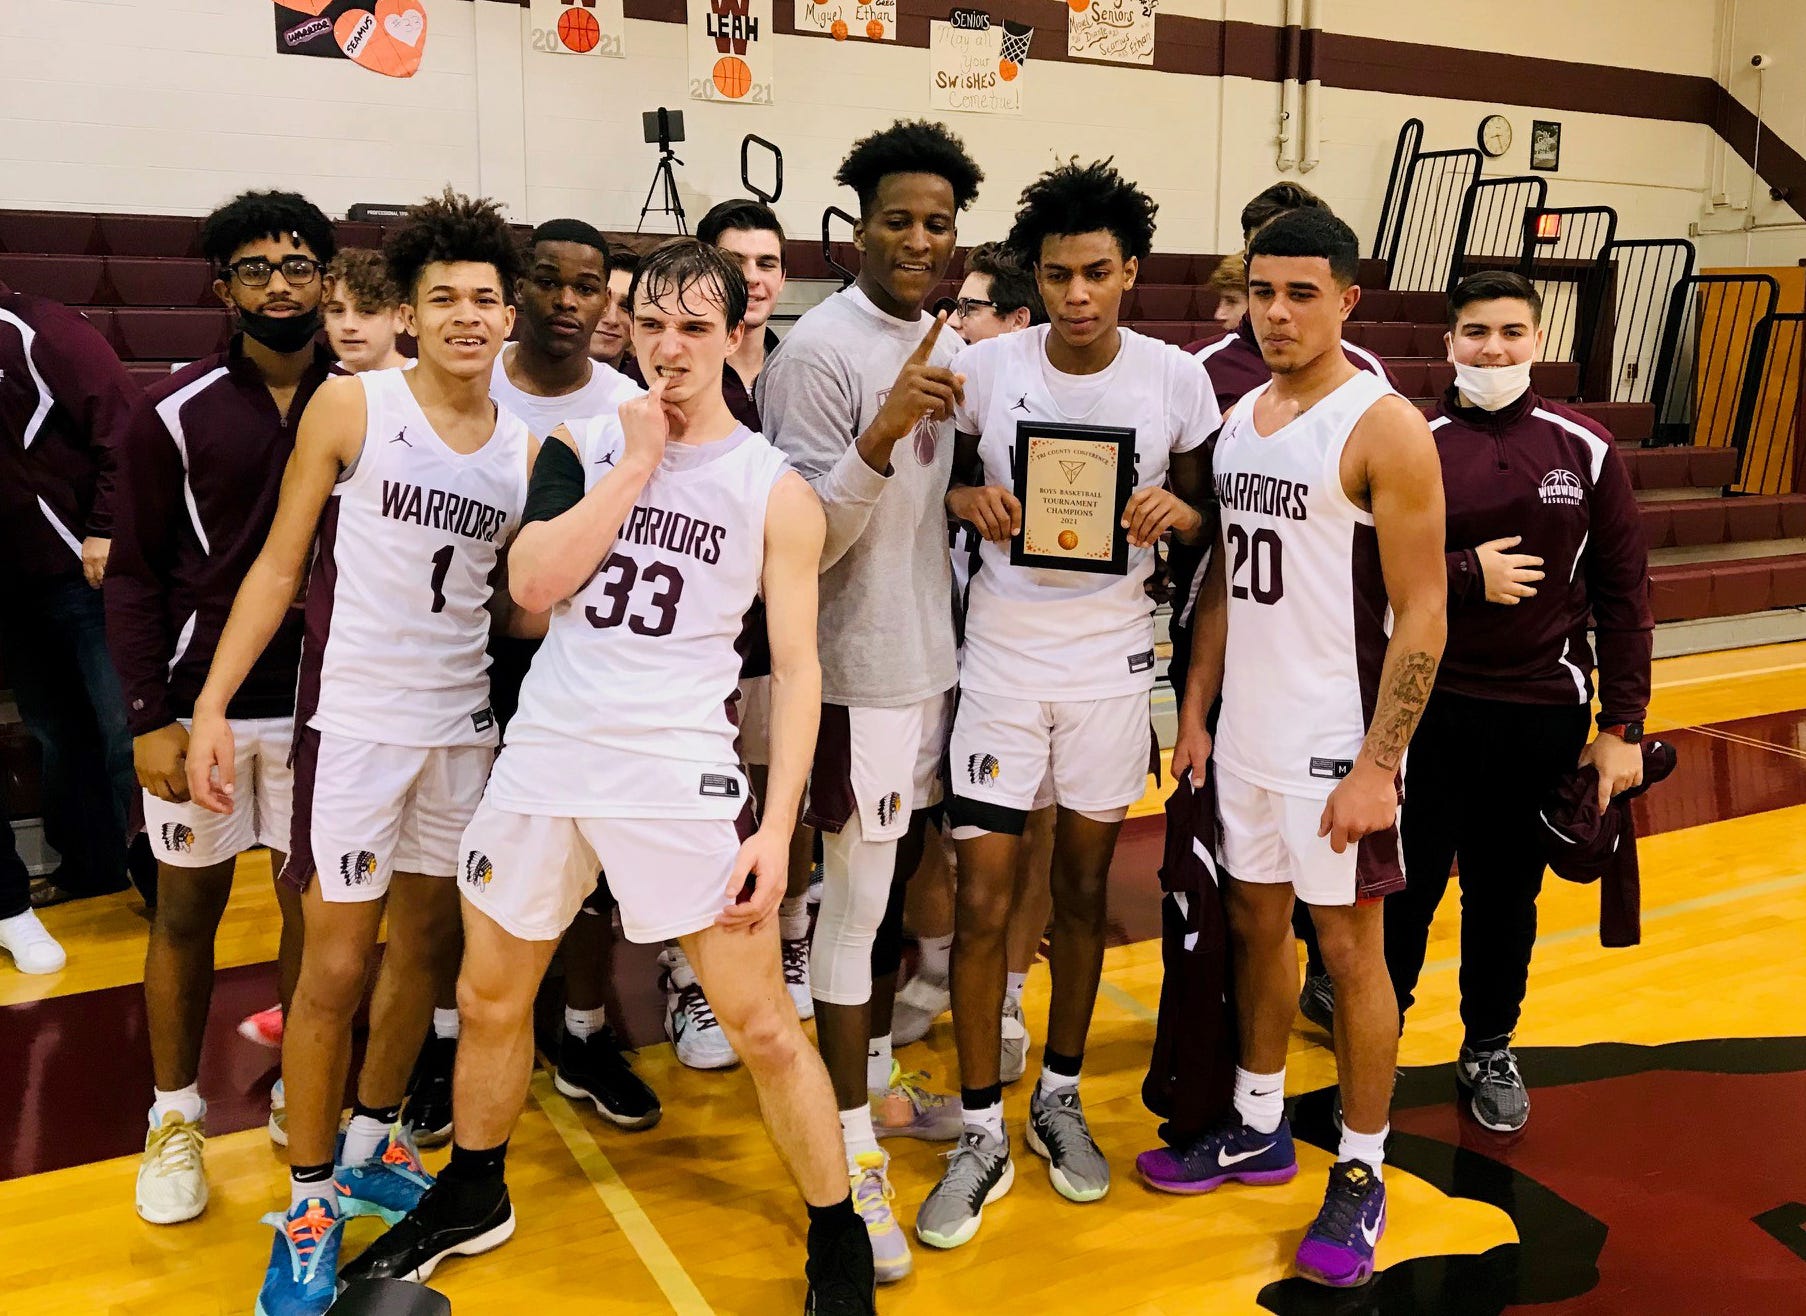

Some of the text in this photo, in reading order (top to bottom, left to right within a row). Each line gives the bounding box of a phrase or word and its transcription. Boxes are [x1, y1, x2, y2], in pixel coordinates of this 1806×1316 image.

[805, 3, 843, 28] Miguel
[855, 5, 894, 23] Ethan
[1092, 2, 1134, 23] Seniors
[288, 20, 330, 42] WARRIOR
[346, 15, 373, 54] SEAMUS
[706, 12, 759, 41] LEAH
[531, 28, 624, 57] 20 21
[975, 31, 992, 48] all
[690, 78, 774, 105] 20 21
[1037, 448, 1109, 466] TRI COUNTY CONFERENCE
[1039, 487, 1102, 499] BOYS BASKETBALL
[1042, 497, 1099, 508] TOURNAMENT
[1538, 484, 1584, 500] WILDWOOD
[1542, 497, 1580, 506] BASKETBALL
[382, 479, 507, 543] WARRIORS
[1046, 506, 1094, 517] CHAMPIONS
[1060, 517, 1078, 525] 2021
[1227, 523, 1284, 606] 20
[431, 544, 455, 614] 1
[584, 552, 685, 638] 33
[1338, 765, 1347, 774] M
